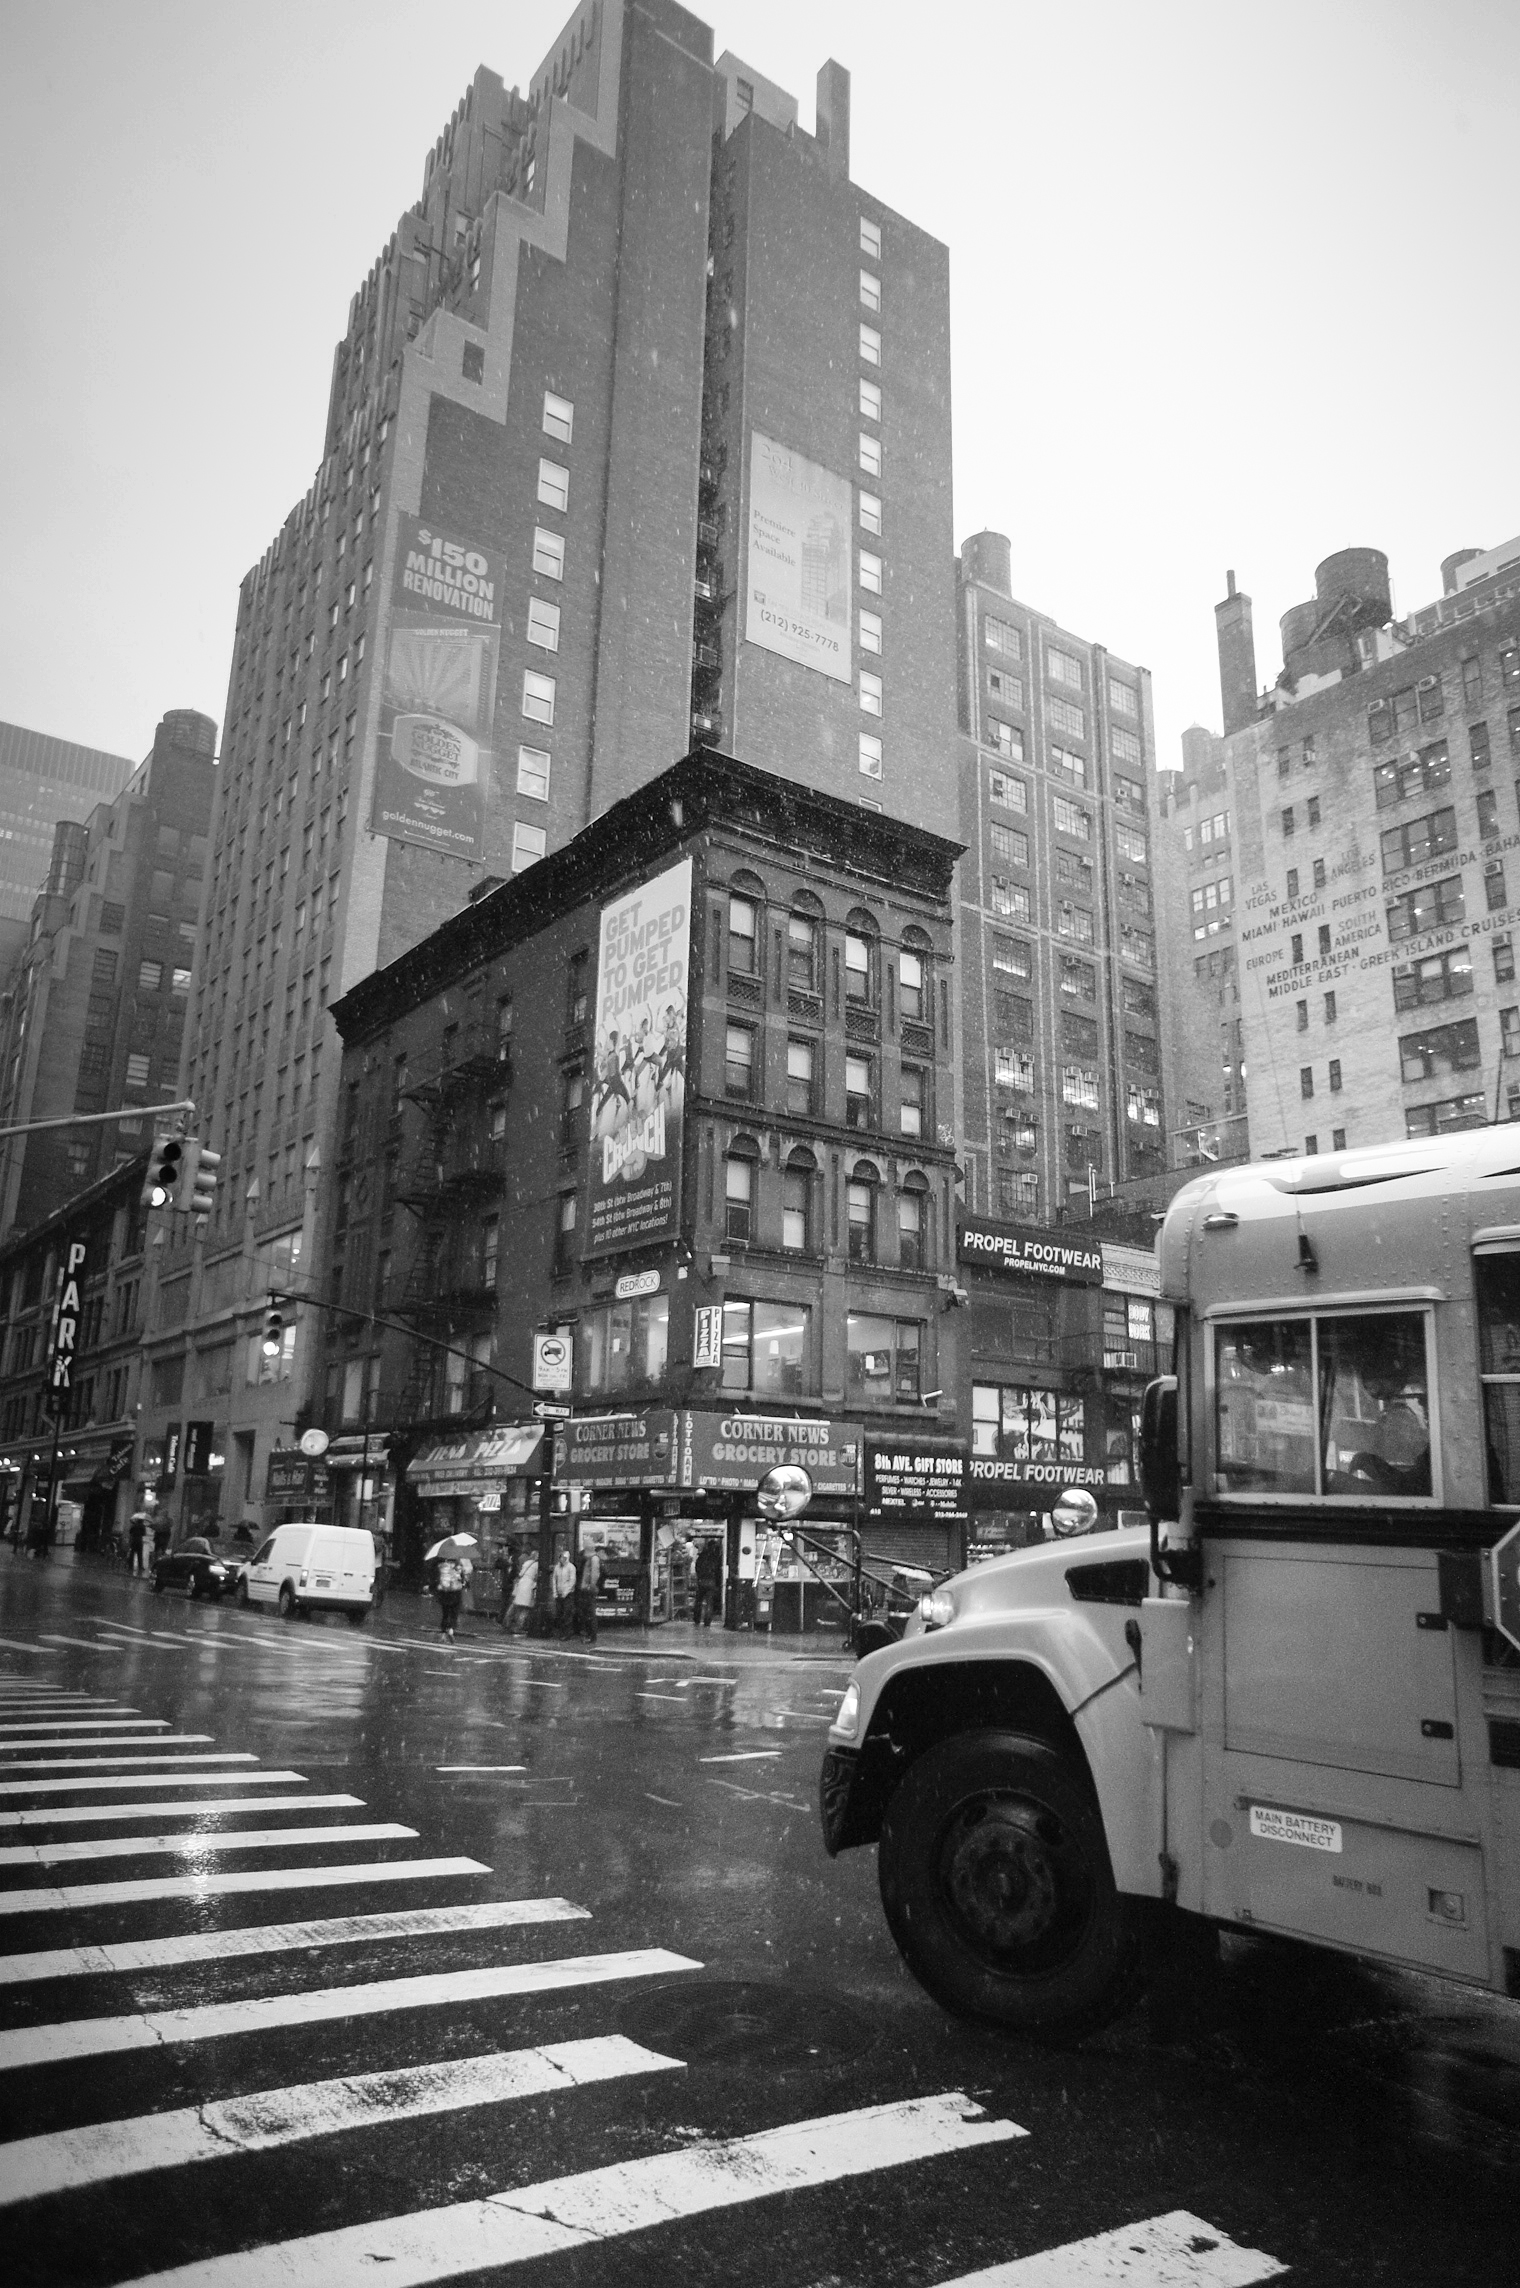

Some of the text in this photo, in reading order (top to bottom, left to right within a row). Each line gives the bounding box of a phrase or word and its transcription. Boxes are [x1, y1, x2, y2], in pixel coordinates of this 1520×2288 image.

[753, 509, 796, 538] Premiere
[753, 524, 780, 545] Space
[418, 528, 489, 576] $150
[752, 539, 797, 567] Available
[406, 550, 495, 601] MILLION
[403, 568, 494, 621] RENOVATION
[760, 609, 788, 632] (212)
[792, 623, 839, 652] 925-7778
[411, 739, 460, 761] NUGGET
[412, 730, 461, 753] GOLDEN
[444, 768, 460, 780] CITY
[382, 810, 475, 844] goldennugget.com
[1331, 853, 1375, 881] ANGELES
[1242, 920, 1277, 942] MIAMI
[1282, 904, 1326, 928] HAWAII
[1331, 886, 1377, 911] PUERTO
[1382, 874, 1411, 893] RICO
[1416, 850, 1478, 881] BERMUDA
[1245, 890, 1277, 910] VEGAS
[1251, 880, 1269, 895] LAS
[1269, 892, 1318, 919] MEXICO
[605, 900, 643, 942] GET
[1338, 910, 1377, 933] SOUTH
[604, 904, 686, 970] PUMPED
[1334, 923, 1383, 949] AMERICA
[603, 935, 673, 995] TO GET
[1245, 948, 1285, 971] EUROPE
[1266, 946, 1360, 987] MEDITERRANEAN
[1268, 975, 1313, 999] MIDDLE
[1318, 963, 1349, 983] EAST
[1360, 948, 1399, 970] GREEK
[1405, 930, 1455, 956] ISLAND
[602, 960, 684, 1023] PUMPED
[602, 1101, 666, 1185] CRUNCH
[607, 1198, 614, 1209] St
[627, 1187, 654, 1203] Broadway
[654, 1183, 660, 1195] &
[605, 1213, 613, 1225] St
[626, 1203, 654, 1219] Broadway
[653, 1199, 659, 1211] &
[593, 1232, 605, 1245] plus
[612, 1225, 628, 1238] other
[627, 1220, 640, 1234] NYC
[640, 1213, 669, 1231] locations!
[963, 1230, 1101, 1270] PROPEL FOOTWEAR
[1004, 1256, 1066, 1275] PROPELNYC.COM
[620, 1274, 657, 1293] REDROCK
[53, 1242, 87, 1388] PARK
[698, 1309, 711, 1357] PIZZA
[712, 1308, 720, 1364] PIZZA
[576, 1420, 647, 1442] CORNER NEWS
[720, 1420, 830, 1445] CORNER NEWS
[570, 1445, 616, 1463] GROCERY
[617, 1442, 650, 1460] STORE
[682, 1411, 693, 1486] LOTTO ATM
[712, 1442, 787, 1464] GROCERY
[790, 1448, 837, 1467] STORE
[874, 1453, 892, 1470] 8th
[892, 1454, 913, 1472] AVE.
[914, 1456, 935, 1473] GIFT
[935, 1458, 963, 1474] STORE
[1024, 1463, 1105, 1485] FOOTWEAR
[721, 1477, 740, 1487] PHOTO
[875, 1474, 900, 1485] PERFUMES
[903, 1475, 926, 1486] WATCHES
[881, 1485, 958, 1498] SILVER WIRELESS ACCESSORIES
[1255, 1810, 1337, 1836] MAIN BATTERY
[1259, 1823, 1333, 1847] DISCONNECT
